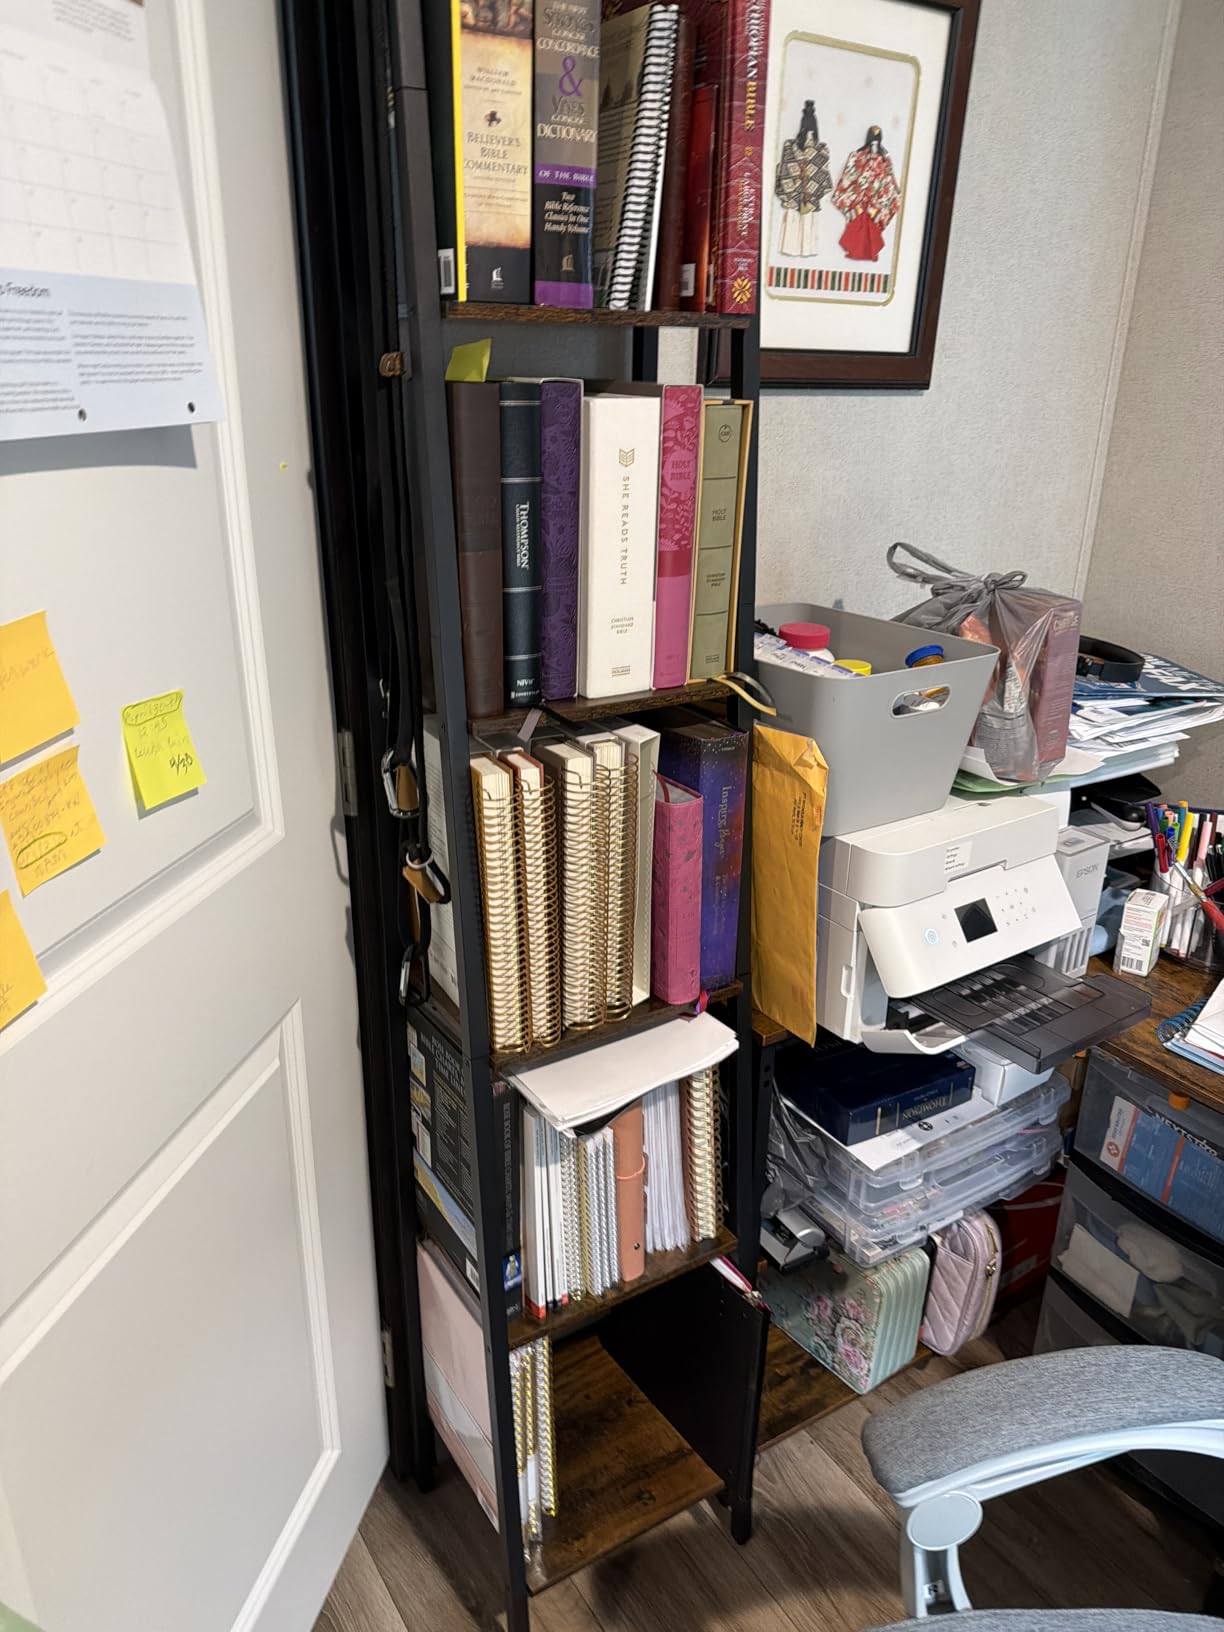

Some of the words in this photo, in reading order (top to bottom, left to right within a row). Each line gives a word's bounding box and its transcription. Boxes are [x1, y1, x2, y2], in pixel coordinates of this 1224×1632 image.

[559, 55, 582, 96] &
[537, 123, 597, 142] DICTIONARY
[480, 147, 509, 160] BIBLE
[463, 159, 528, 175] COMMENTARY
[554, 171, 570, 180] THE
[621, 475, 630, 499] SHE
[519, 501, 530, 570] THOMPSON
[620, 504, 629, 543] READS
[619, 549, 628, 585] TRUTH
[716, 785, 732, 828] Inspire
[1076, 864, 1099, 878] EPSON
